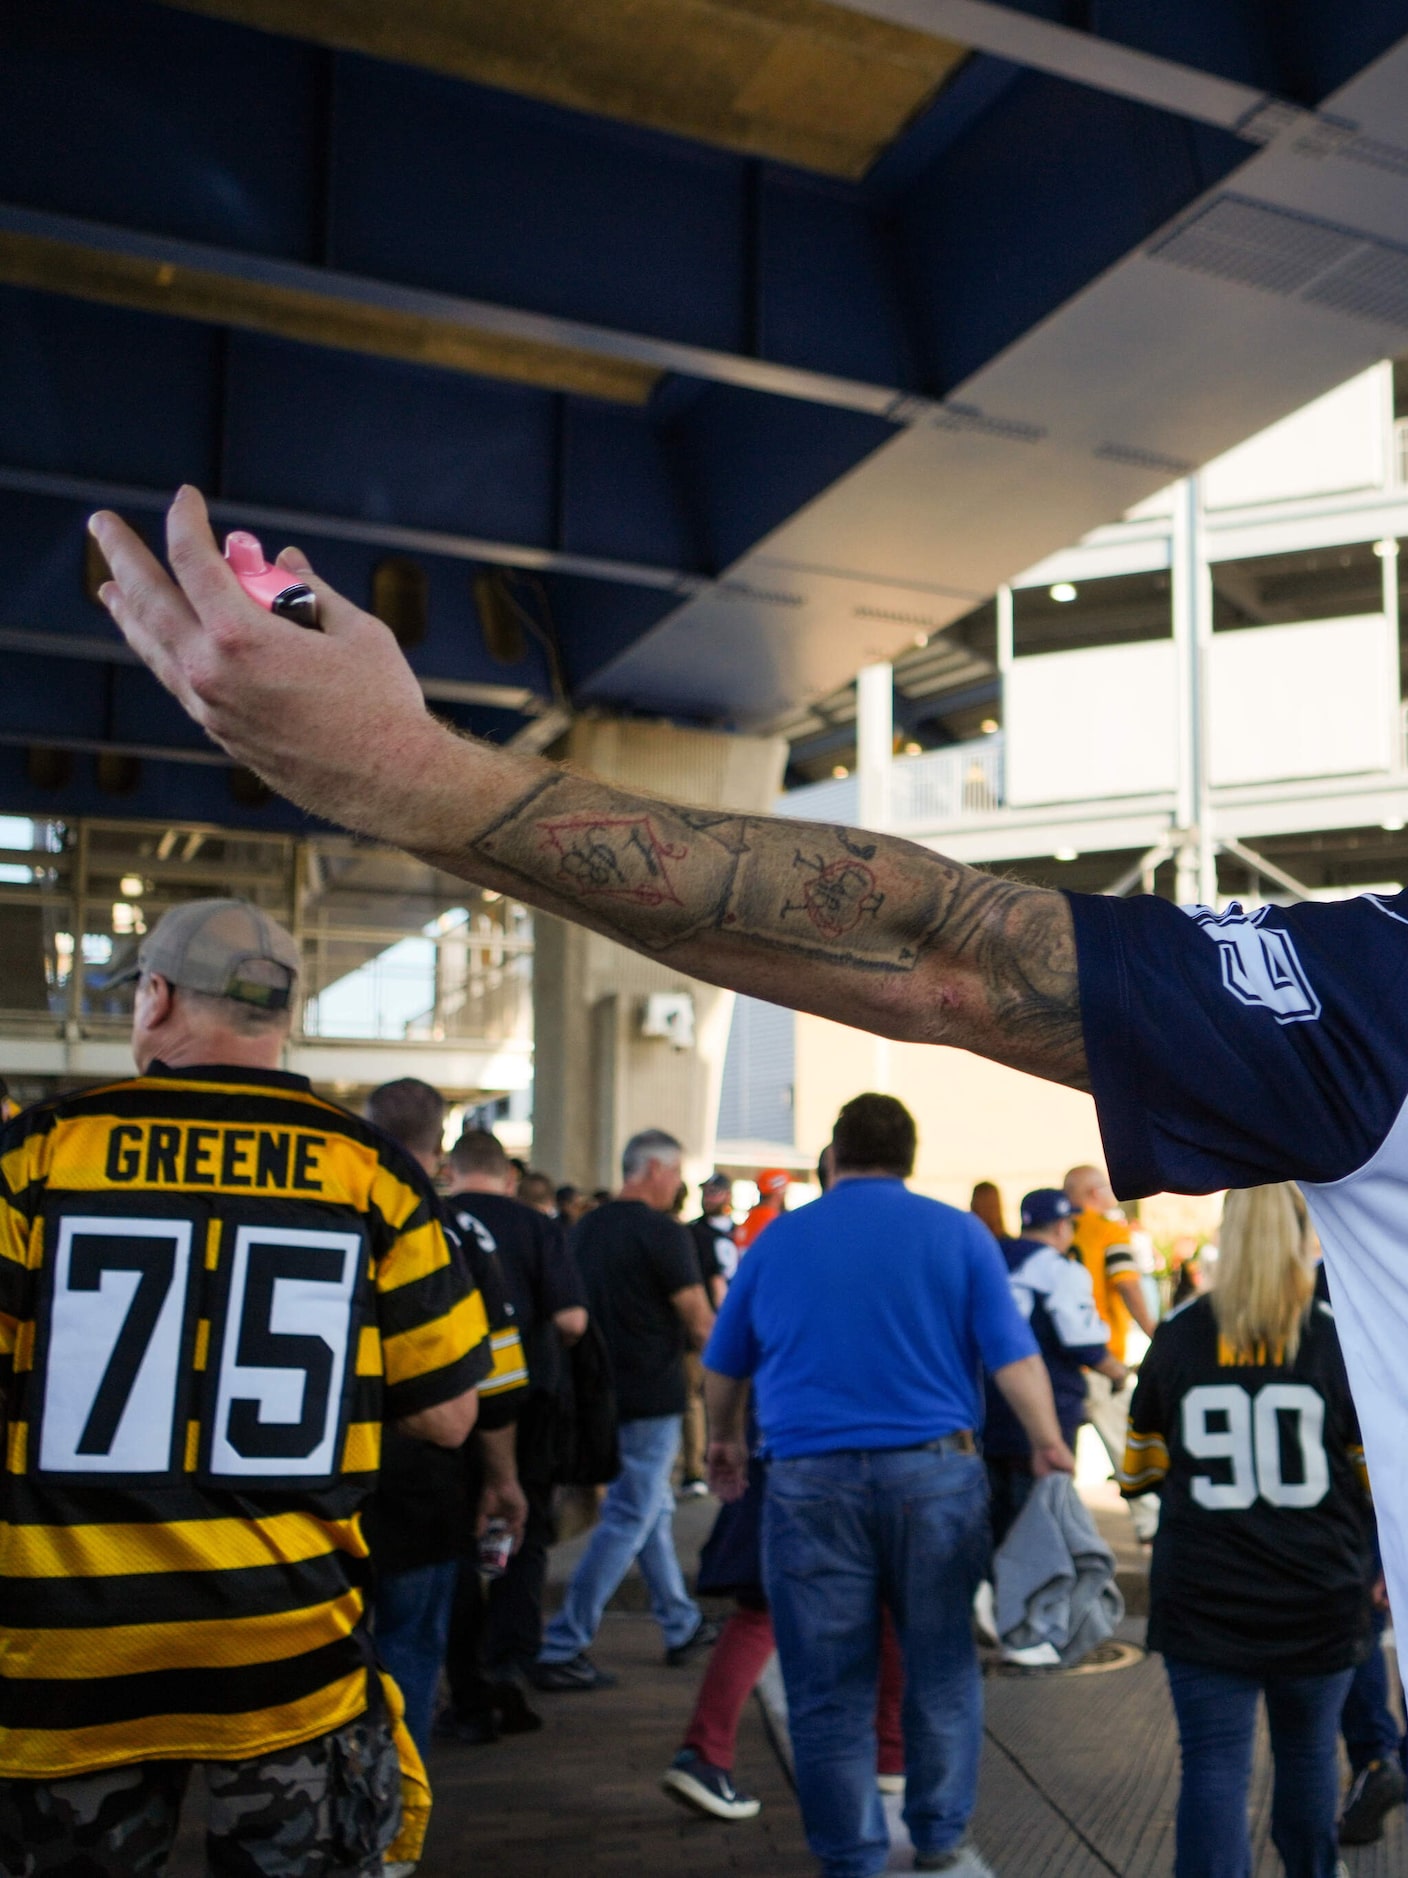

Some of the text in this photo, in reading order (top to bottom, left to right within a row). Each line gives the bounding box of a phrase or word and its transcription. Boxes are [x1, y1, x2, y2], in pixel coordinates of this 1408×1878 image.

[105, 1124, 328, 1192] GREENE
[39, 1215, 361, 1476] 75
[1181, 1383, 1331, 1510] 90
